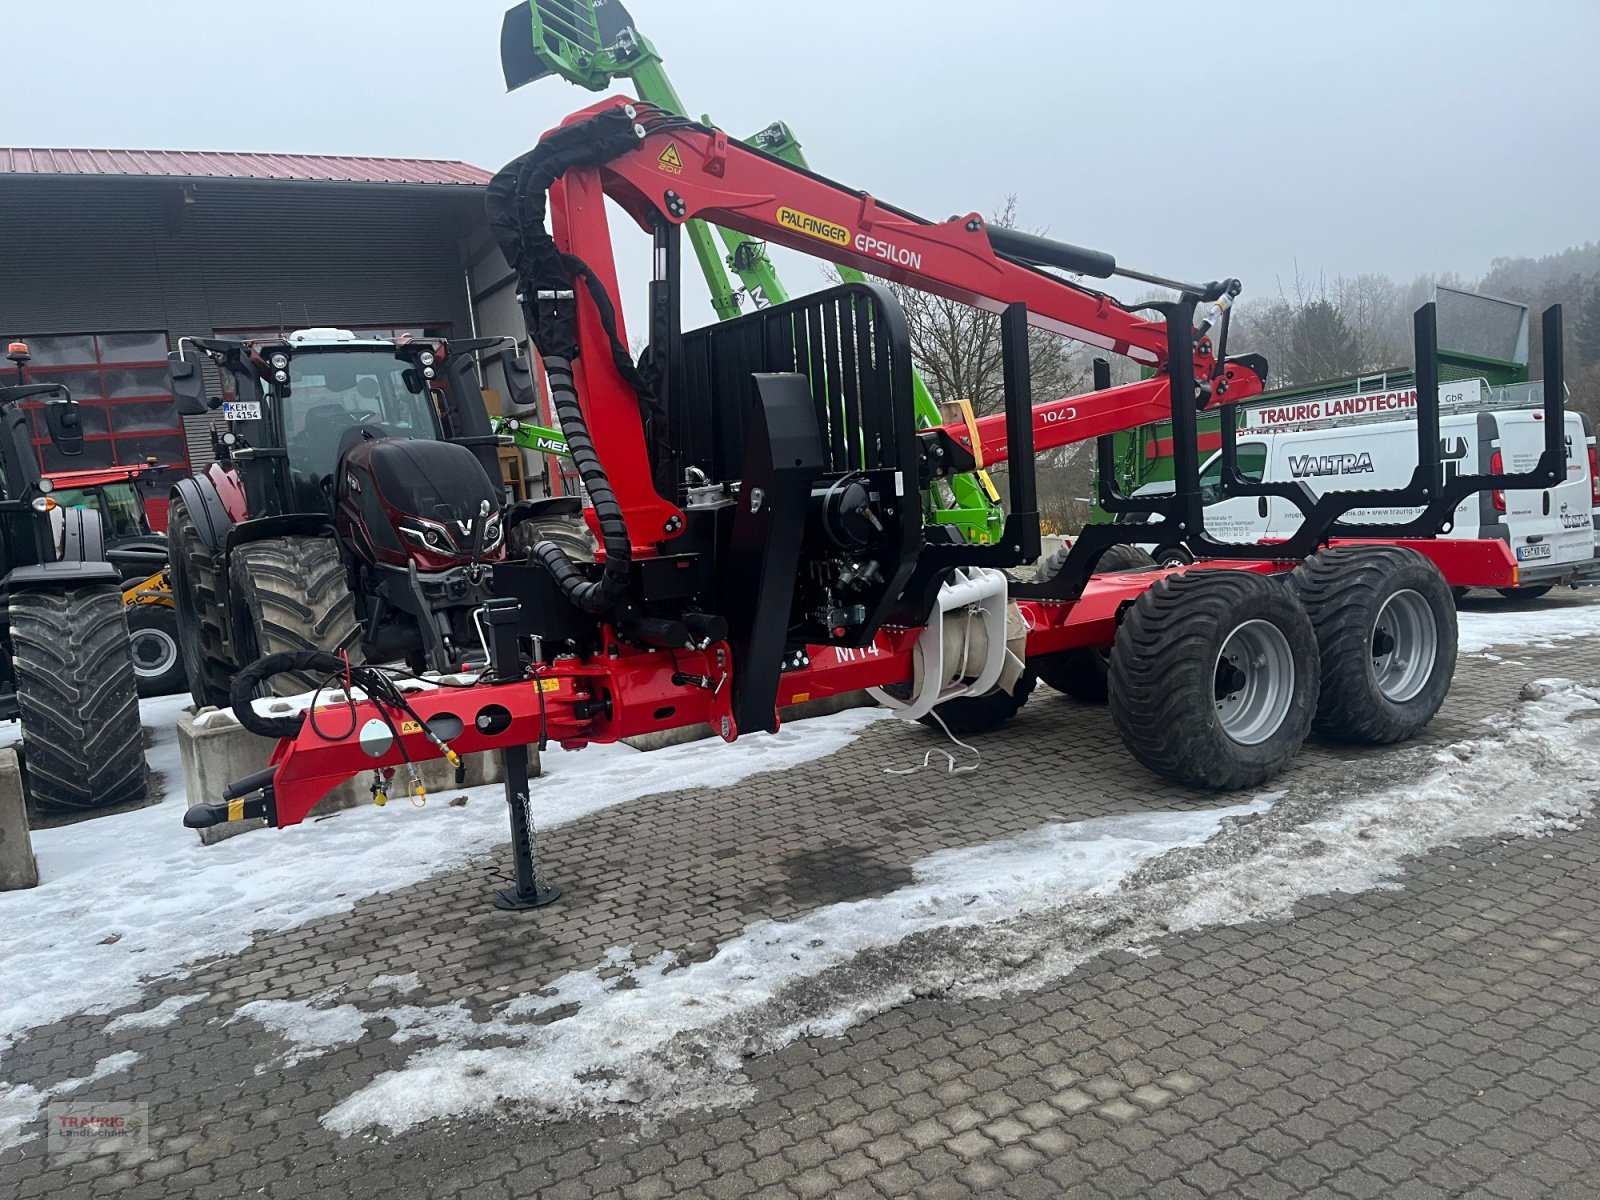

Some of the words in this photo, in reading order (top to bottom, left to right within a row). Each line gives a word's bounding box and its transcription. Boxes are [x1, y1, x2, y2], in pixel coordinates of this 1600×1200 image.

[781, 210, 846, 242] PALFINGER
[855, 234, 921, 270] EPSILON
[1259, 404, 1321, 425] TRAURIG
[1325, 389, 1438, 416] LANDTECHN
[1445, 393, 1463, 403] GbR
[1288, 452, 1374, 478] VALTRA
[835, 640, 879, 663] M14
